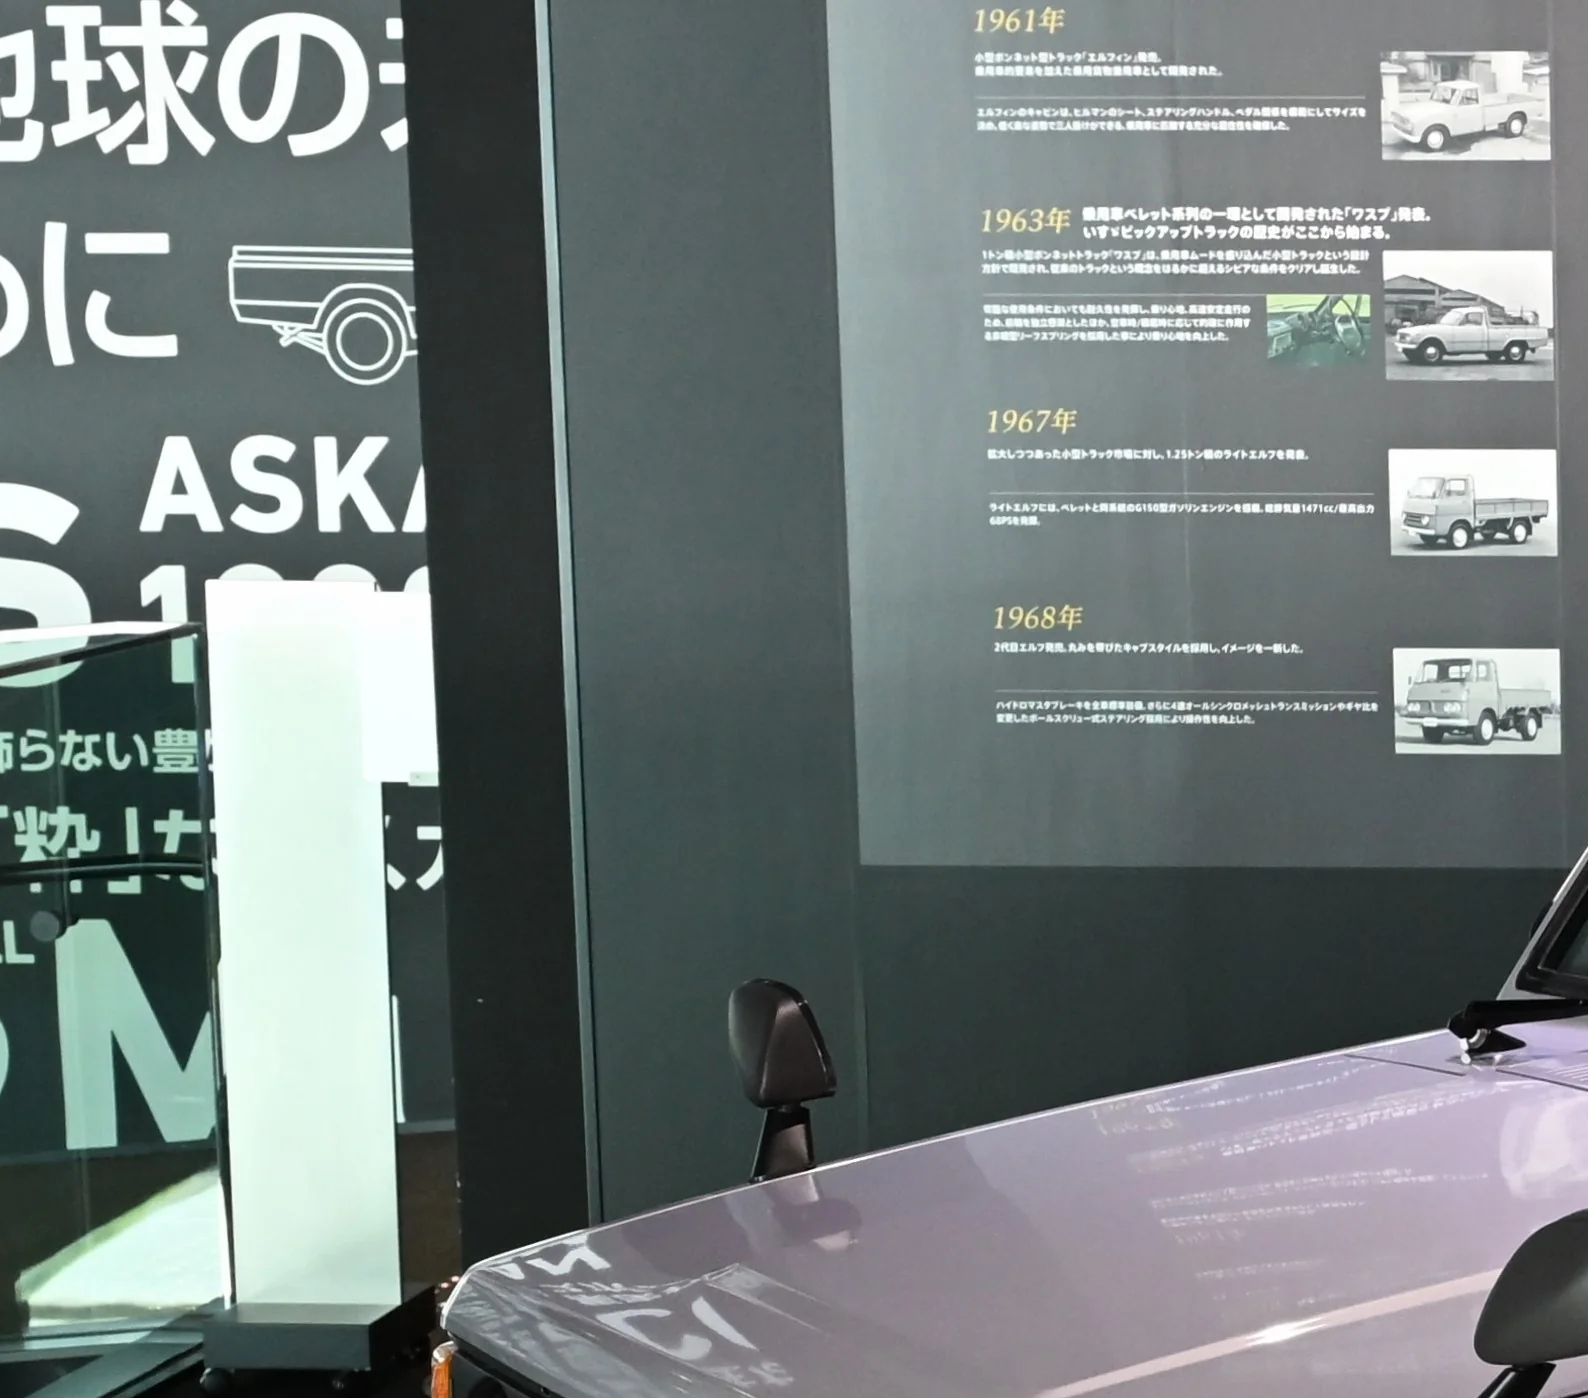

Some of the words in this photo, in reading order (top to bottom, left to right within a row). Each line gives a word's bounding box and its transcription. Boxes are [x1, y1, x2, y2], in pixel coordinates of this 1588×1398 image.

[974, 6, 1066, 34] 1961年
[0, 0, 409, 165] 球の
[982, 207, 1072, 234] 1963年
[988, 407, 1078, 435] 1967年
[994, 605, 1083, 631] 1968年
[0, 728, 213, 773] らない豊
